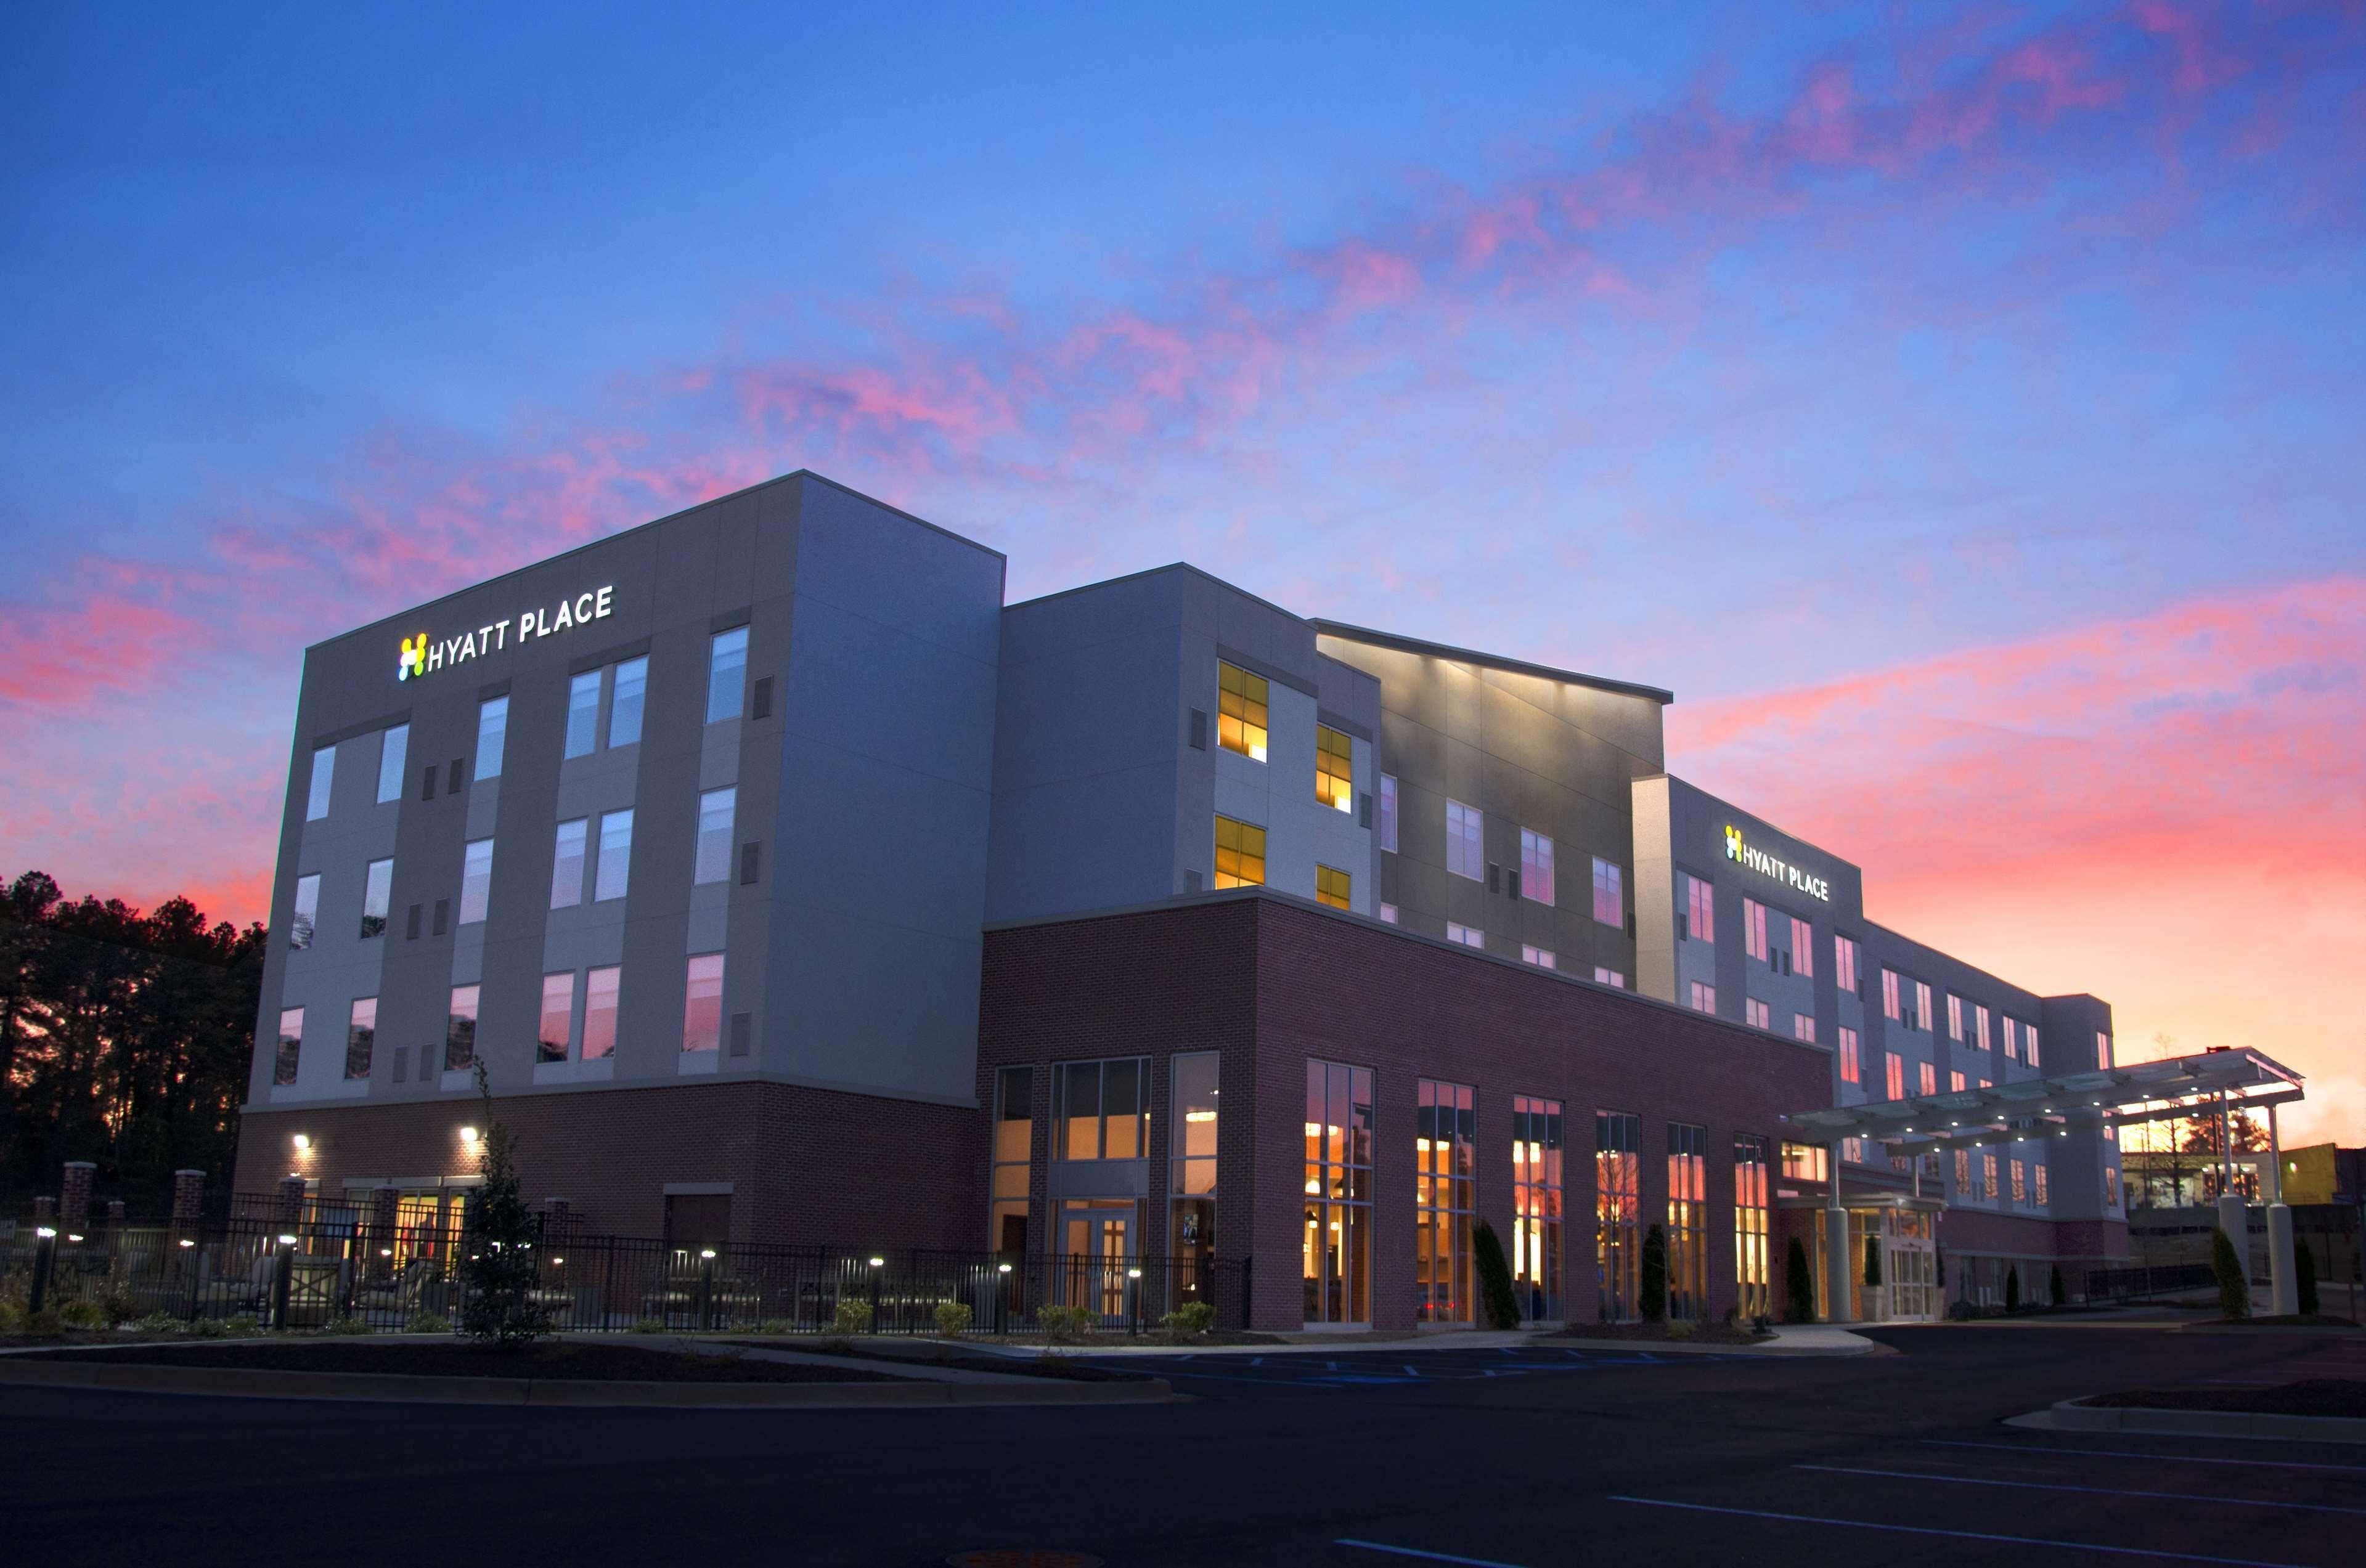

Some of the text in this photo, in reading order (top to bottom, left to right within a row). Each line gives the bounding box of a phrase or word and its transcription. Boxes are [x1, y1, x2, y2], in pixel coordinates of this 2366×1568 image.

[428, 585, 613, 672] HYATT PLACE
[1743, 843, 1829, 901] HYATT PLACE
